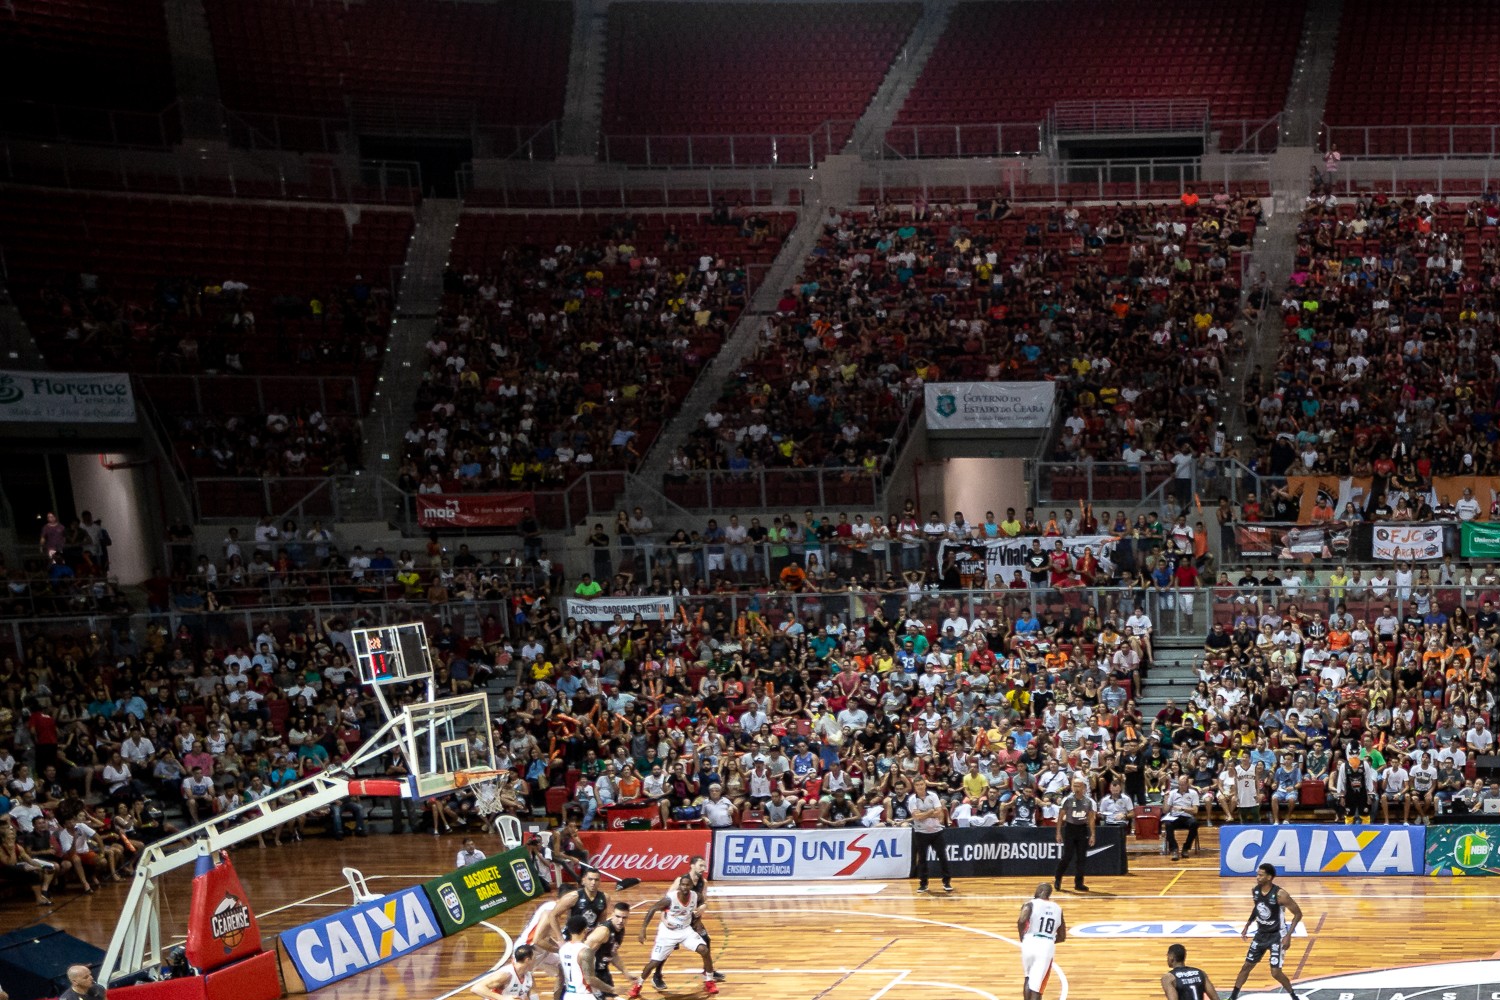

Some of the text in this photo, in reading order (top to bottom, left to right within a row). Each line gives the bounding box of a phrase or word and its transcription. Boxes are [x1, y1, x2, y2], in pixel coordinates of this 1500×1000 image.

[32, 379, 127, 395] Florence
[963, 393, 1008, 402] GOVERNO
[964, 404, 999, 413] ESTADO
[571, 605, 598, 614] ACESSO
[603, 605, 636, 614] CADEIRAS
[589, 843, 689, 870] dweiser
[728, 837, 792, 863] EAD
[802, 833, 902, 877] UNISAL
[1226, 829, 1415, 873] CAIXA
[1471, 845, 1488, 855] NBB
[463, 865, 501, 888] BASQUETE
[727, 863, 790, 874] ENSINO A DISTÂNCIA
[476, 882, 503, 901] BRASIL
[212, 906, 249, 938] CEARENSE
[1039, 917, 1055, 934] 10
[296, 891, 437, 982] CAIXA
